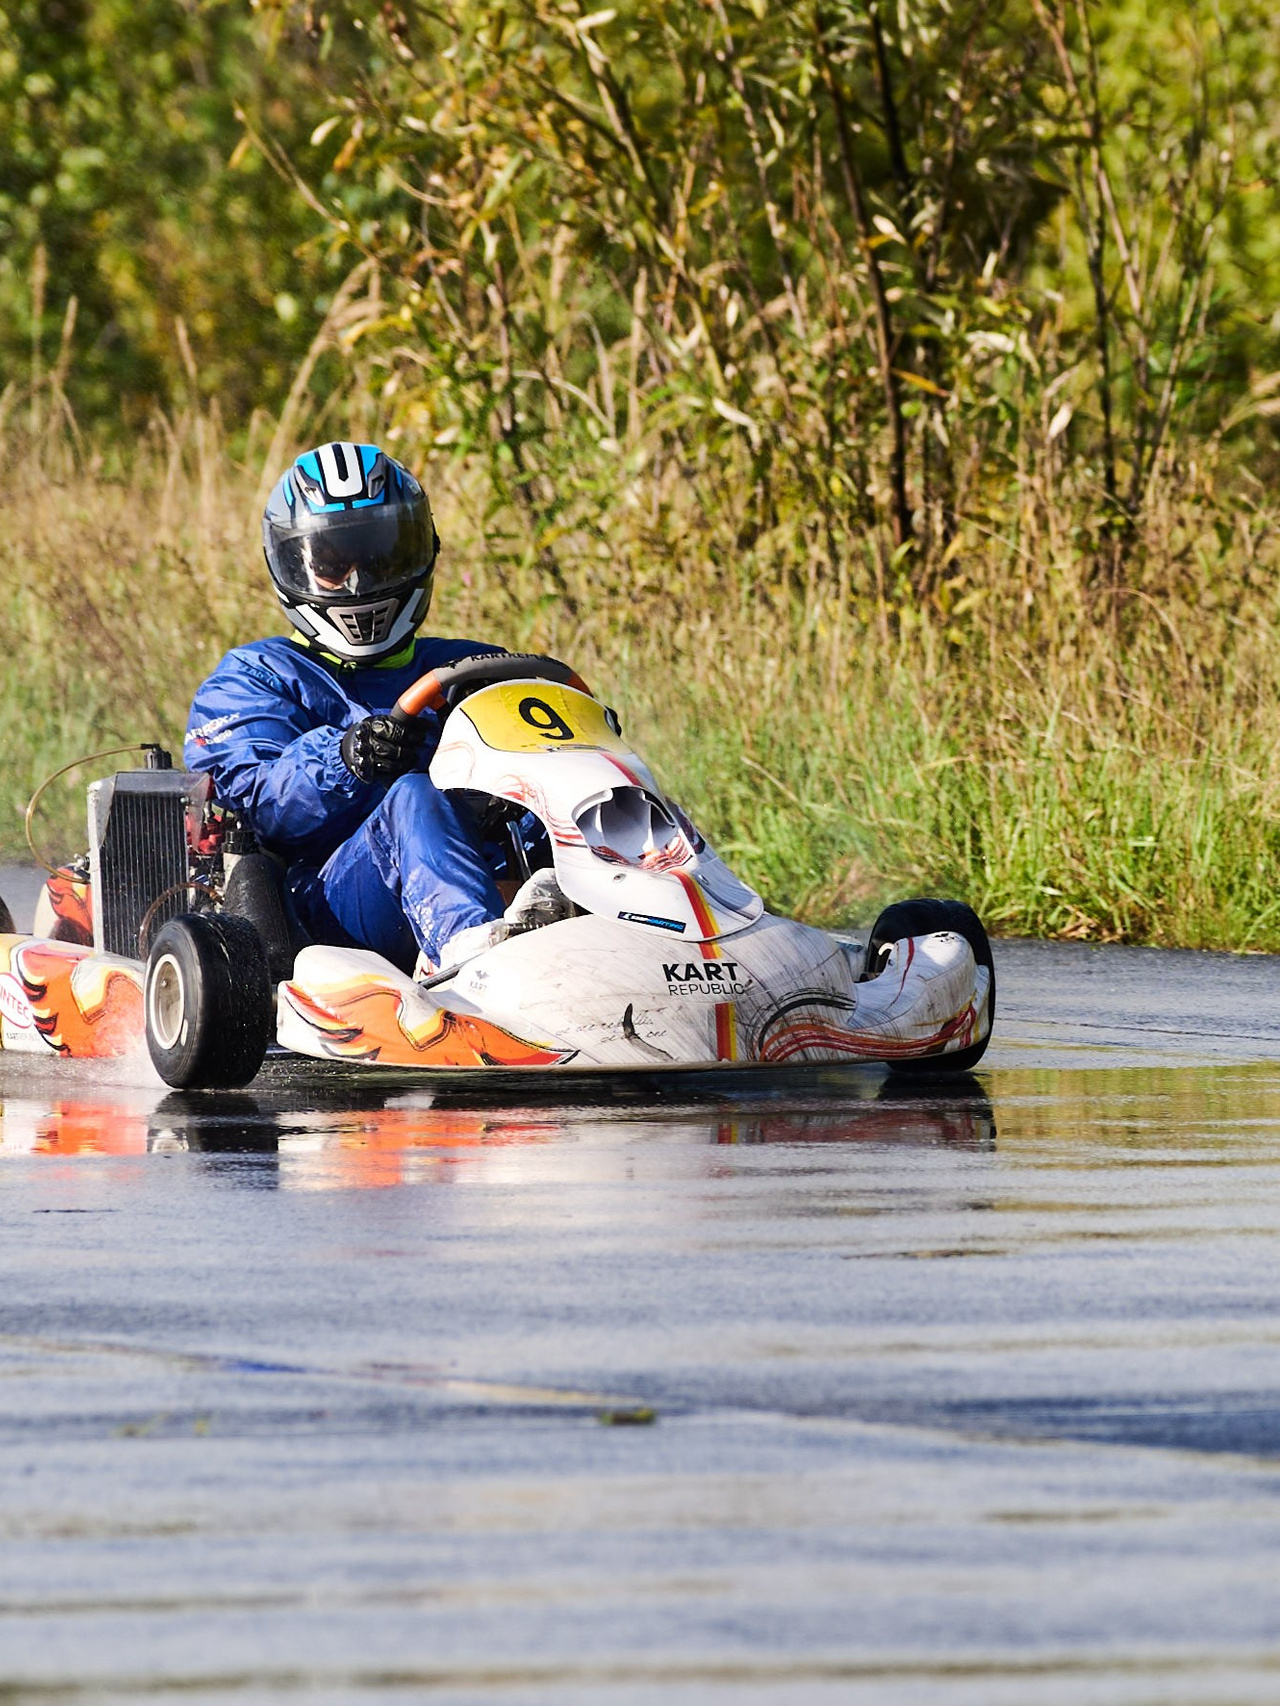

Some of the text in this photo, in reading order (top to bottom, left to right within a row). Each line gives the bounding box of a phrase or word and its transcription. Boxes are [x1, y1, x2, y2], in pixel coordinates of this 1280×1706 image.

[518, 697, 575, 740] 9
[662, 963, 738, 981] KART
[668, 983, 745, 996] REPUBLIC
